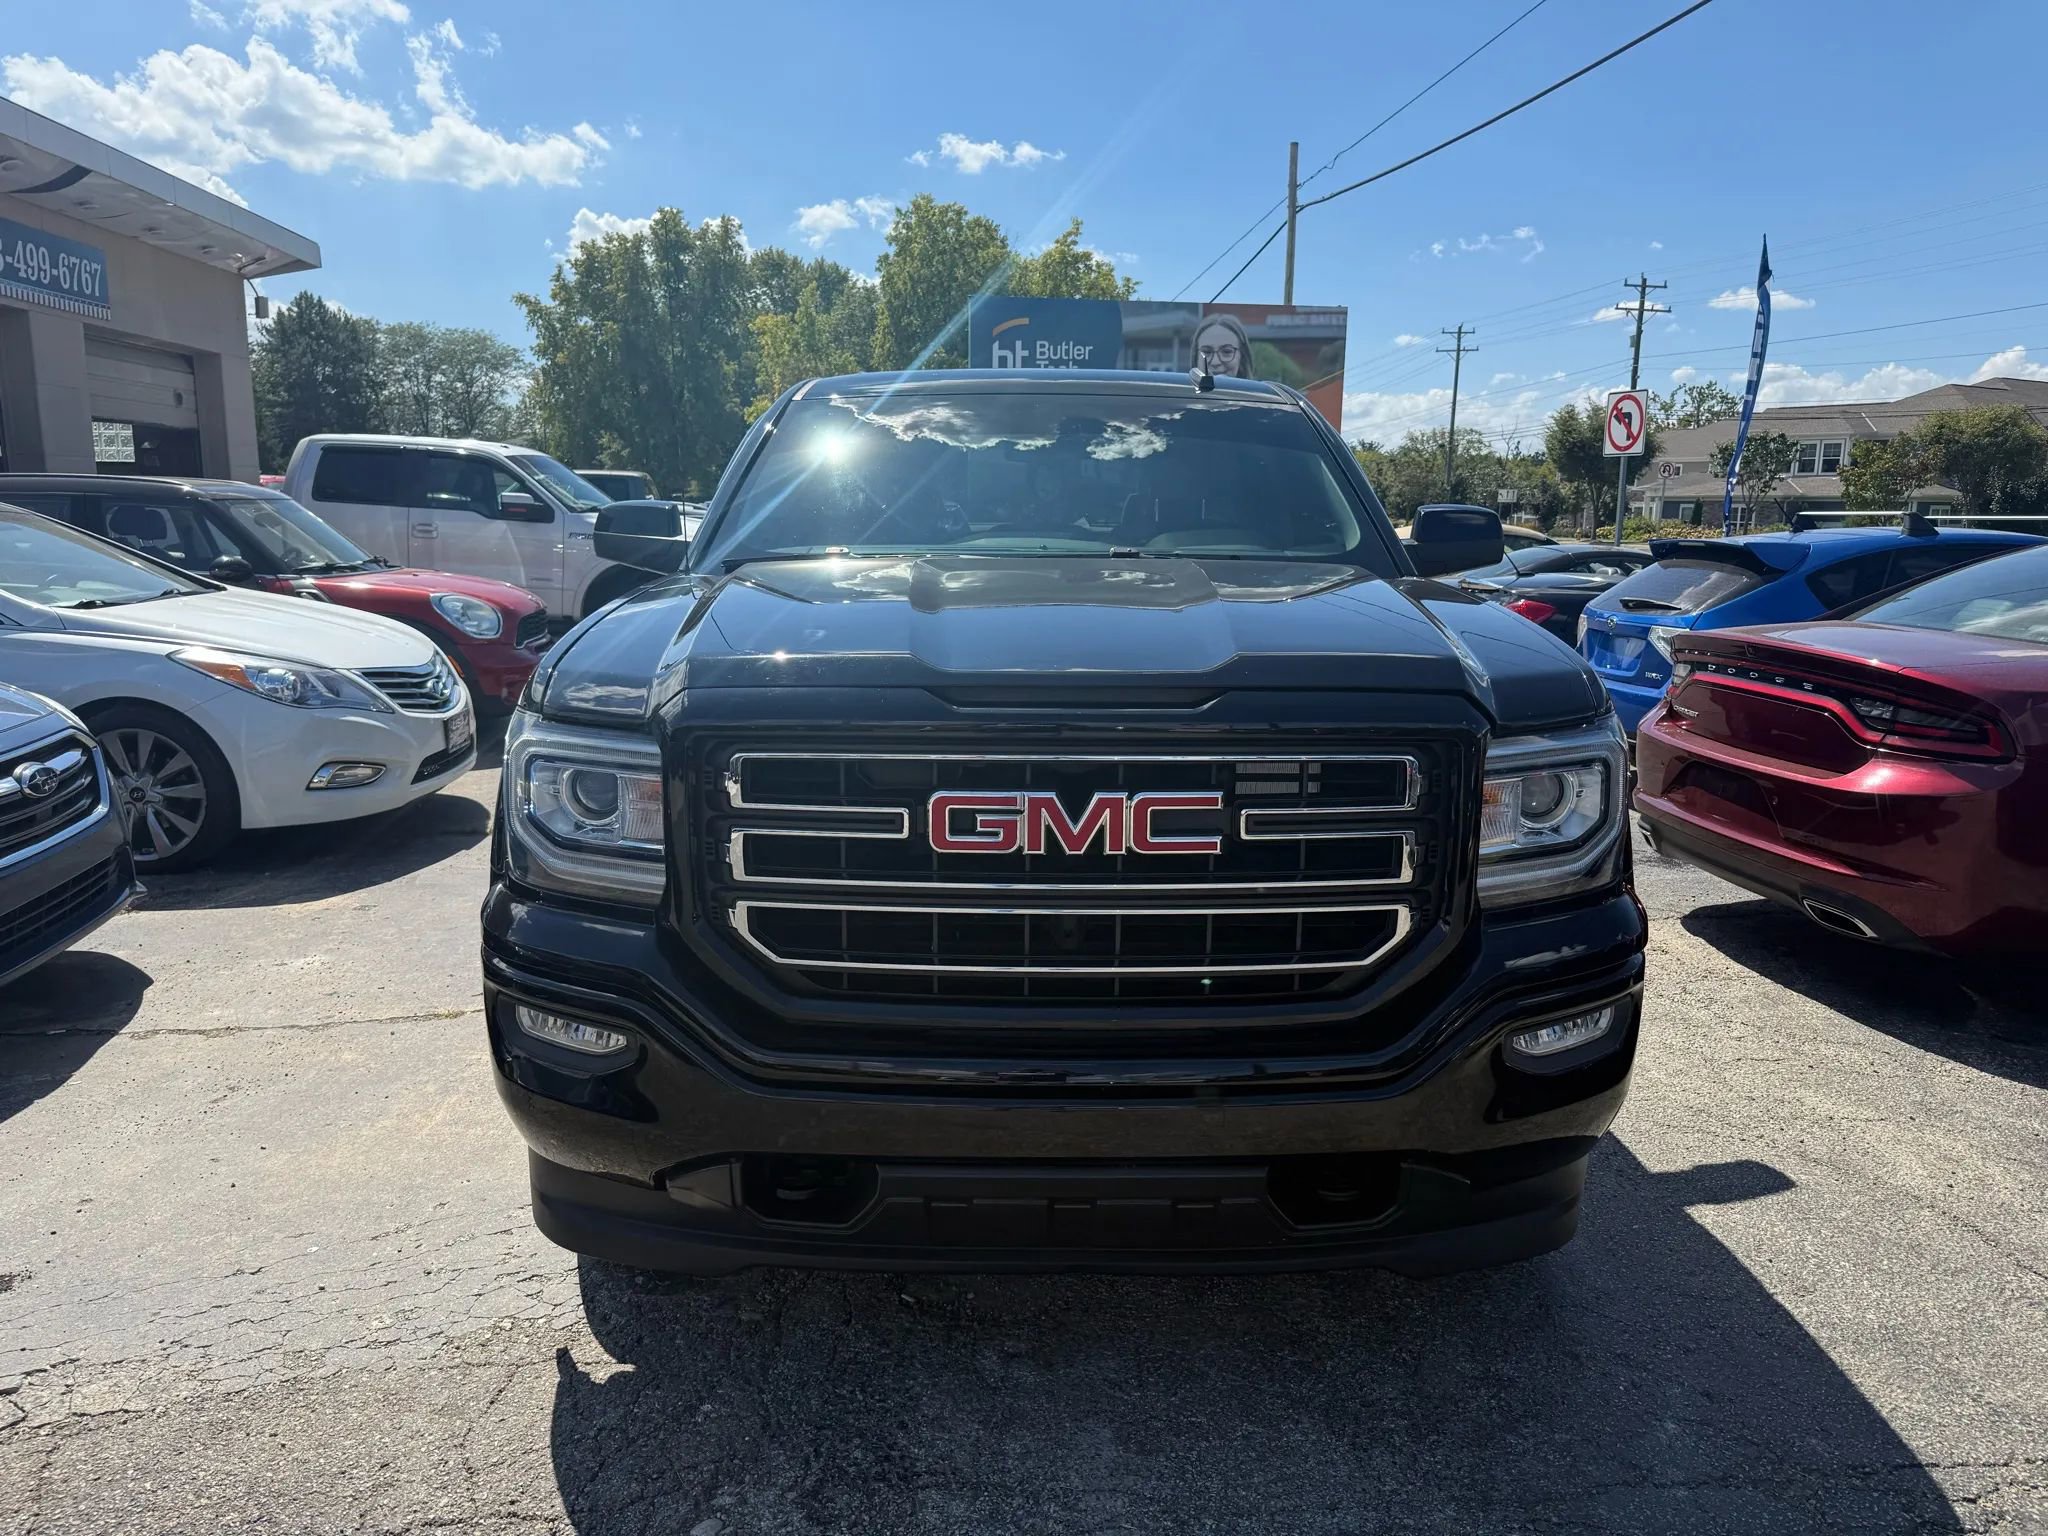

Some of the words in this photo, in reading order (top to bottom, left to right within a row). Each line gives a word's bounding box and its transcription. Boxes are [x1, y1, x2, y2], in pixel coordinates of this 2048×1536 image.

[1036, 341, 1093, 360] Butler
[1708, 664, 1813, 690] DODGE
[928, 791, 1223, 856] GMC
